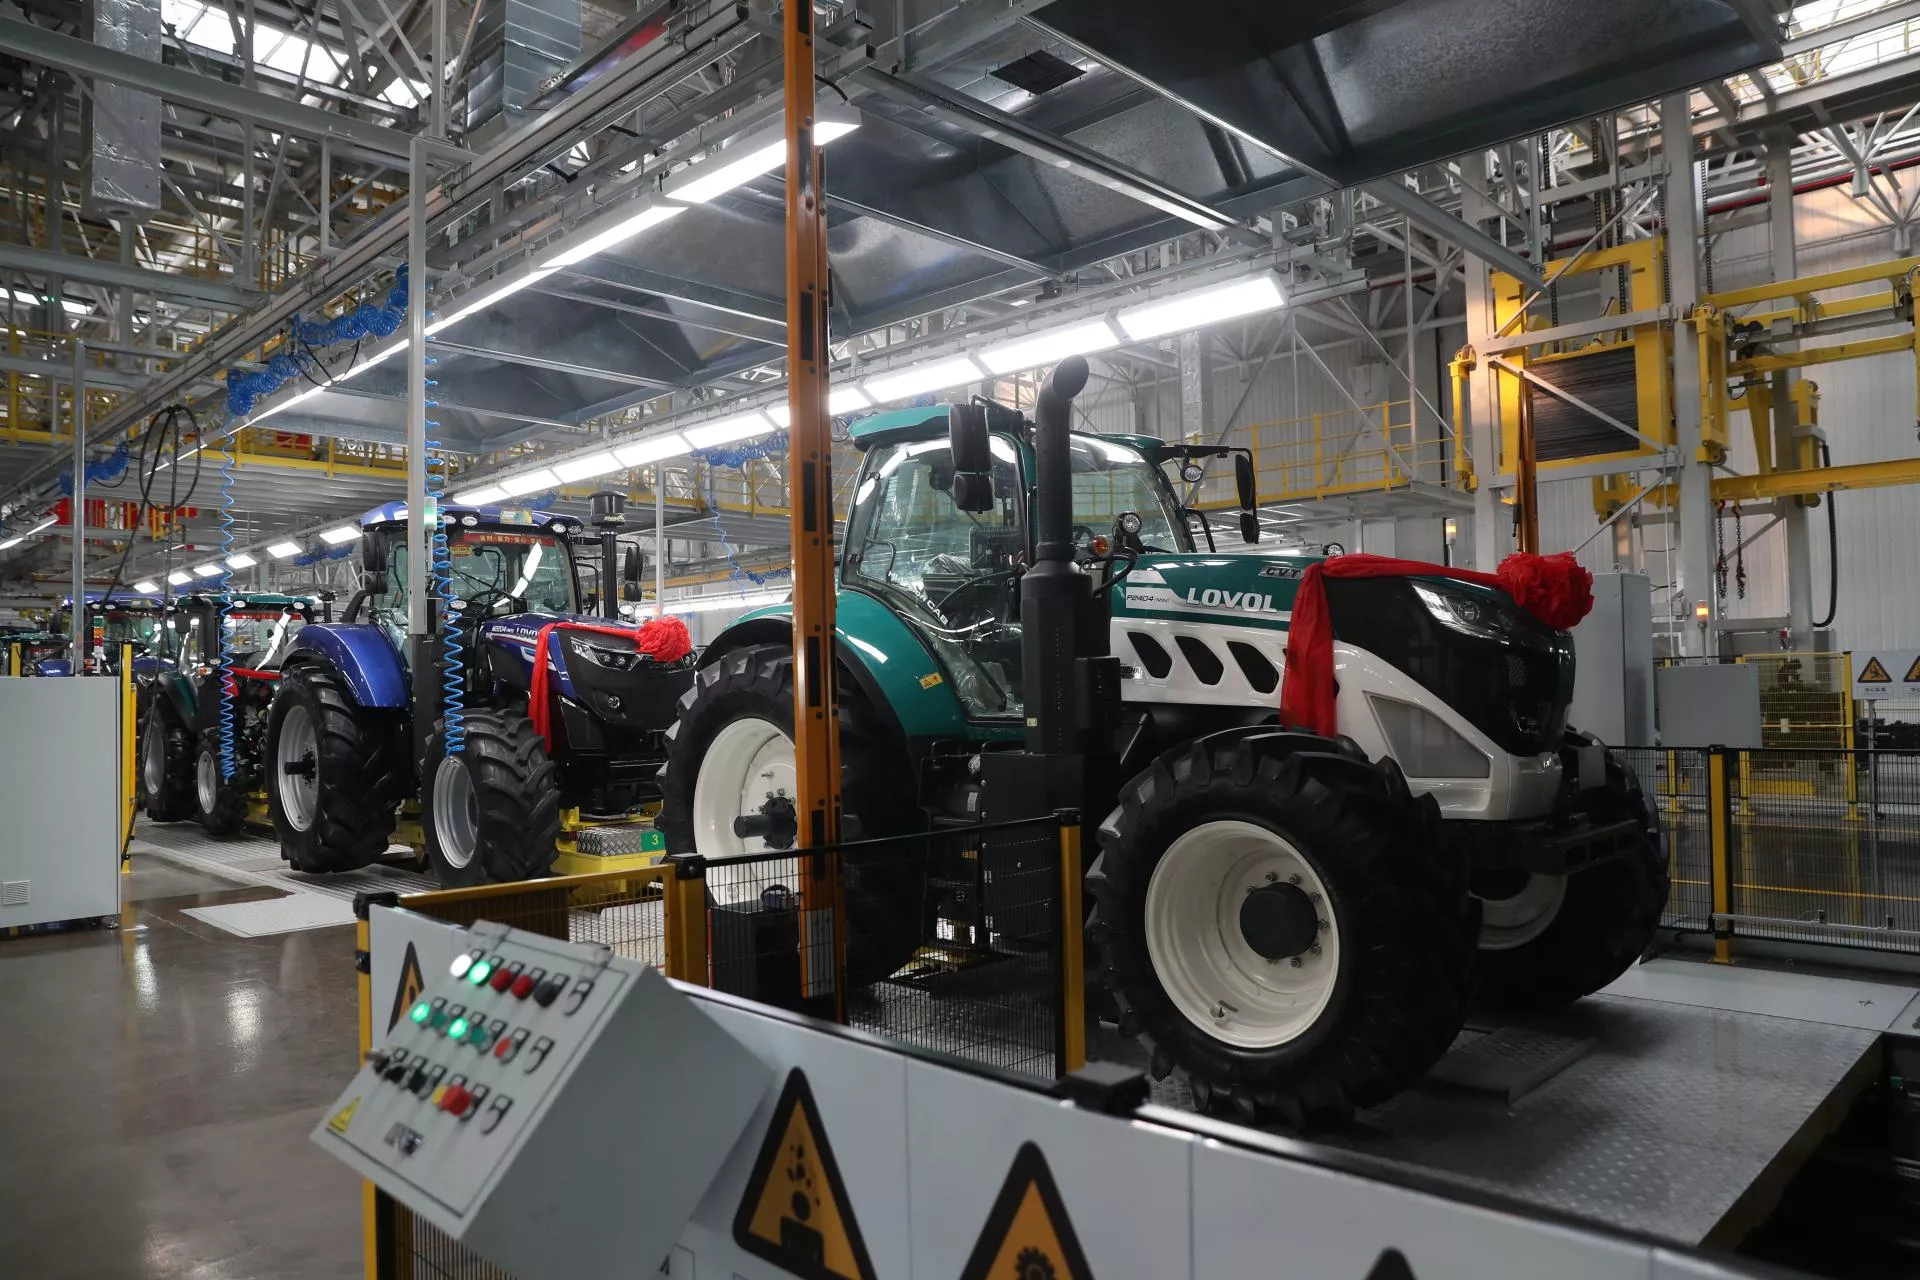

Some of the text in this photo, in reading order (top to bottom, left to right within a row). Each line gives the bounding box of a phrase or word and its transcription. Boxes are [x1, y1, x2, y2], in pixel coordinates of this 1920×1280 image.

[1266, 566, 1302, 578] CVT
[1126, 594, 1154, 602] P2404
[1187, 587, 1278, 613] LOVOL
[926, 599, 949, 625] CAB
[516, 627, 539, 641] LOVO
[652, 834, 659, 845] 3
